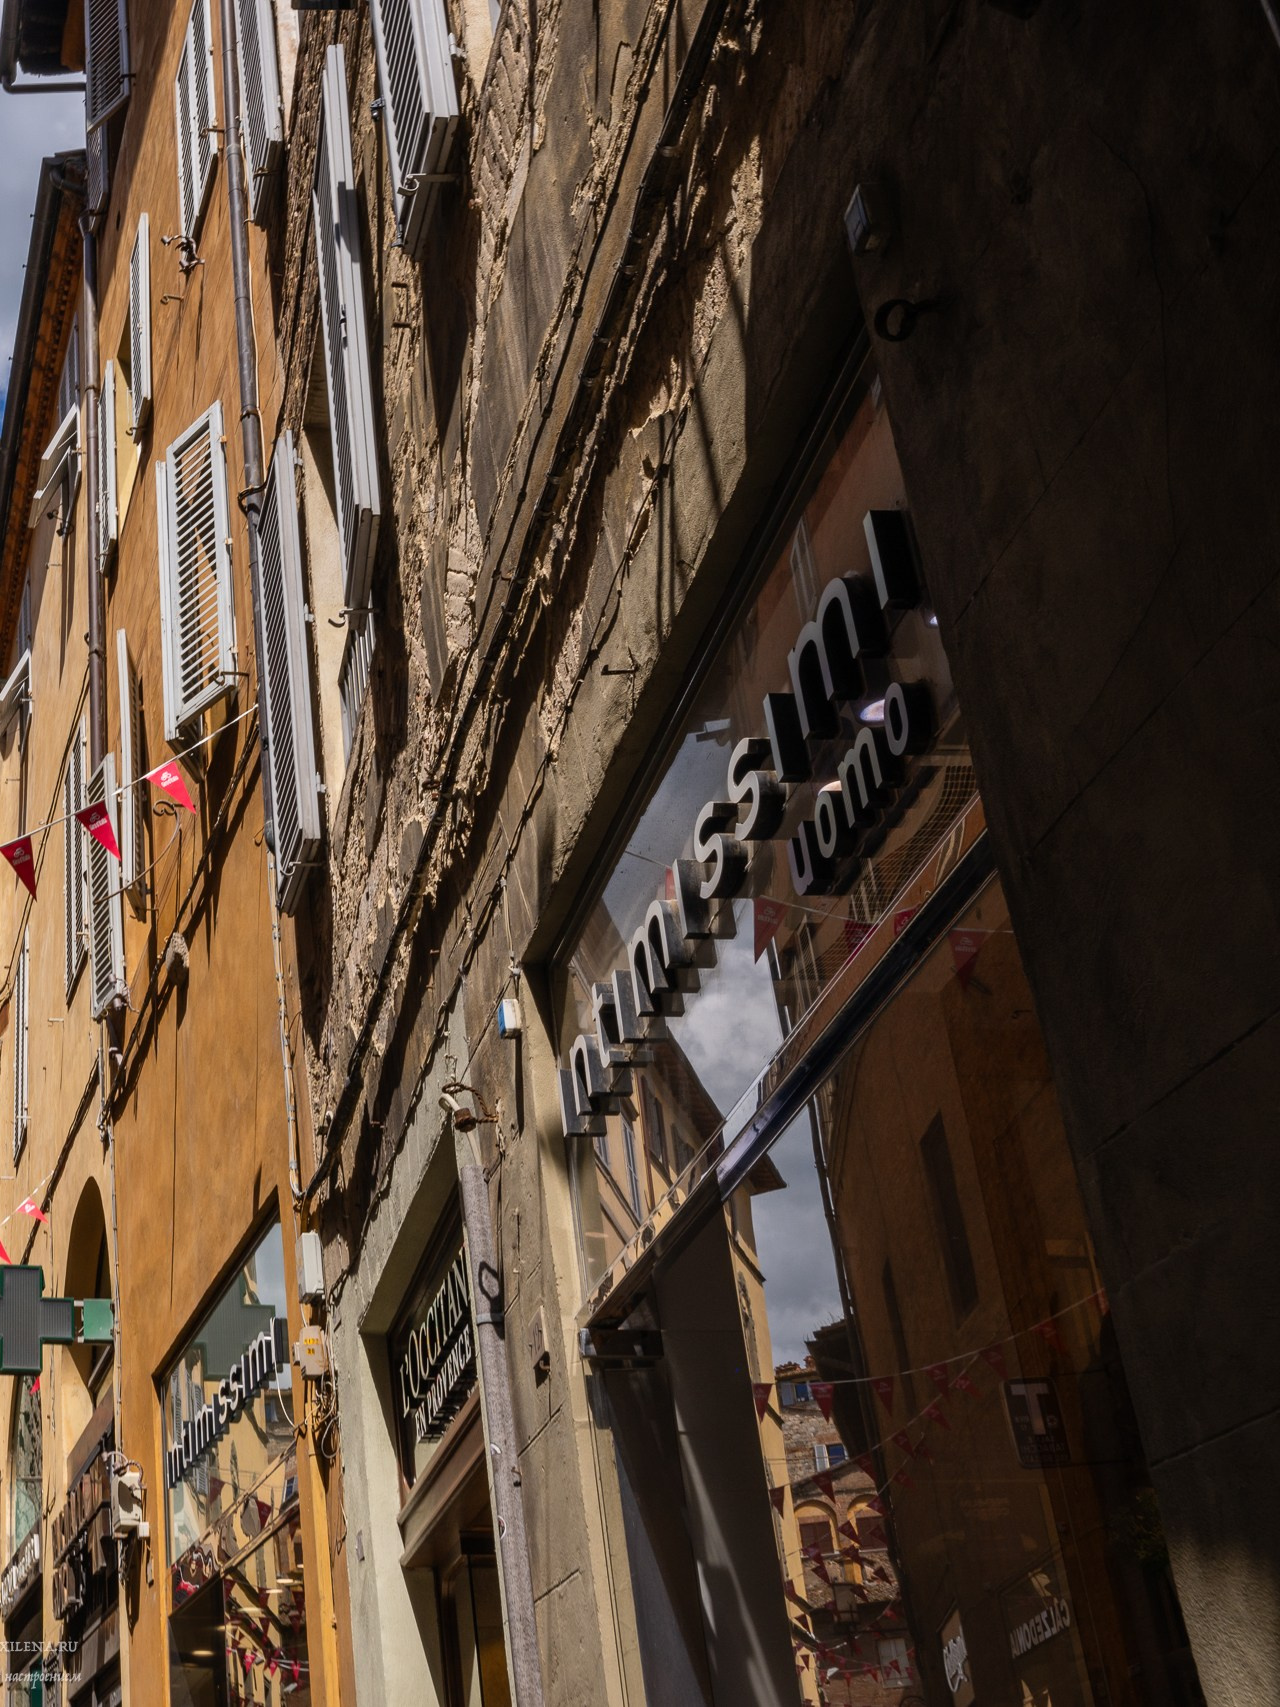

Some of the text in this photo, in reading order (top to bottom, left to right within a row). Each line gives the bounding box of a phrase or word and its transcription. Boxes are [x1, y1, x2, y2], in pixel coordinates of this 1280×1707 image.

[788, 682, 924, 895] uomo
[400, 1245, 470, 1419] L'OCCITAN
[415, 1323, 472, 1443] EN PROVENCE
